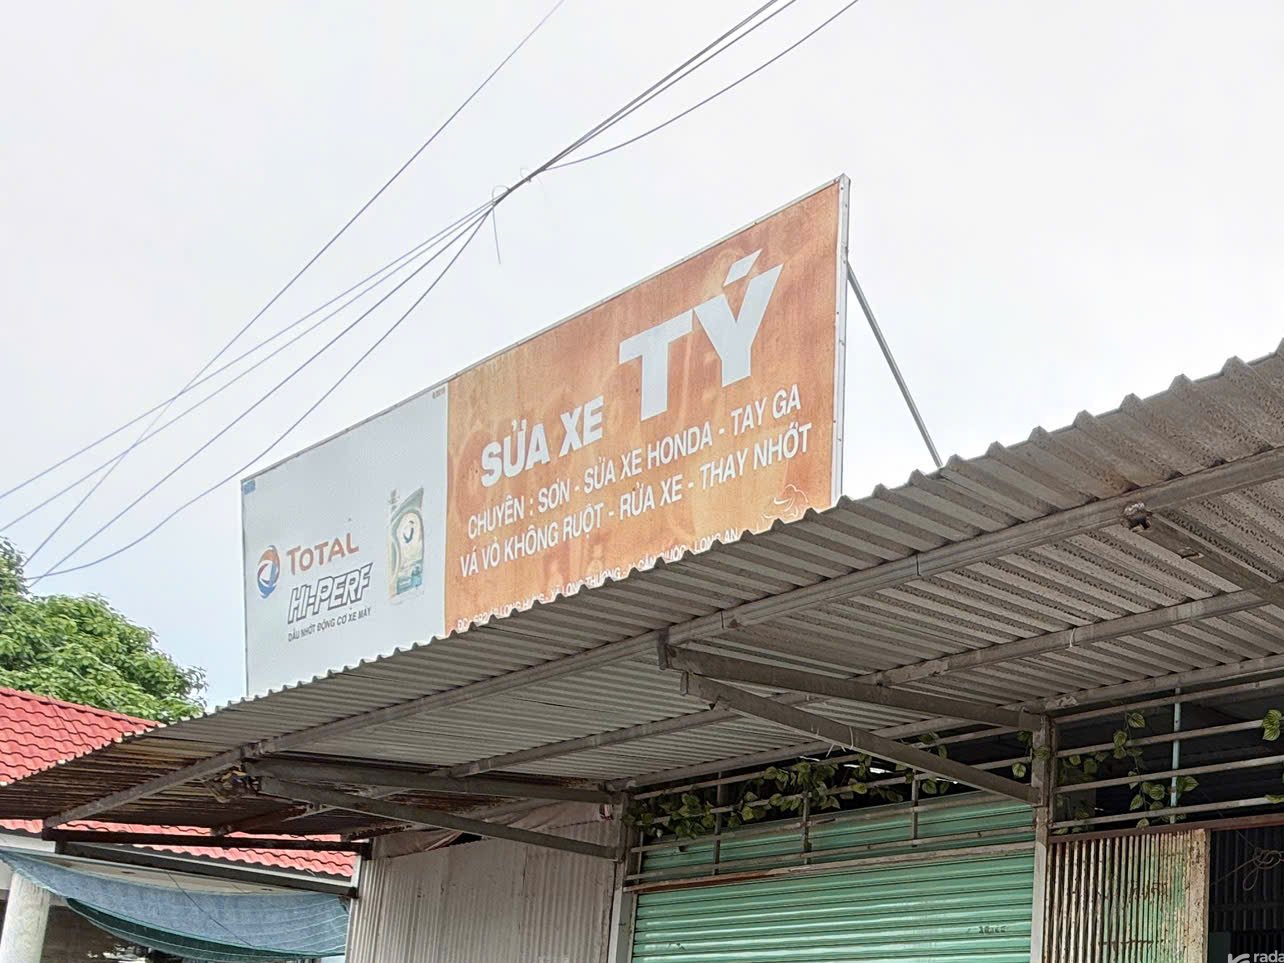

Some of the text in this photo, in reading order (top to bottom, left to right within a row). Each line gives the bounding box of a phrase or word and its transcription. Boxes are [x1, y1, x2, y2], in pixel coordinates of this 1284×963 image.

[481, 248, 784, 487] SỬA XE TÝ
[460, 545, 479, 577] VÁ
[504, 525, 559, 562] KHÔNG
[563, 502, 604, 541] RUỘT
[620, 481, 655, 520] RỬA
[660, 474, 683, 506] XE
[700, 448, 749, 489] THAY
[753, 421, 812, 470] NHỚT
[468, 495, 524, 539] CHUYÊN
[538, 478, 570, 513] SƠN
[584, 456, 616, 494] SỬA
[620, 448, 642, 480] XE
[648, 421, 712, 469] HONDA
[731, 397, 767, 436] TAY
[772, 384, 801, 419] GA
[286, 532, 359, 576] TOTAL
[348, 611, 357, 622] XE
